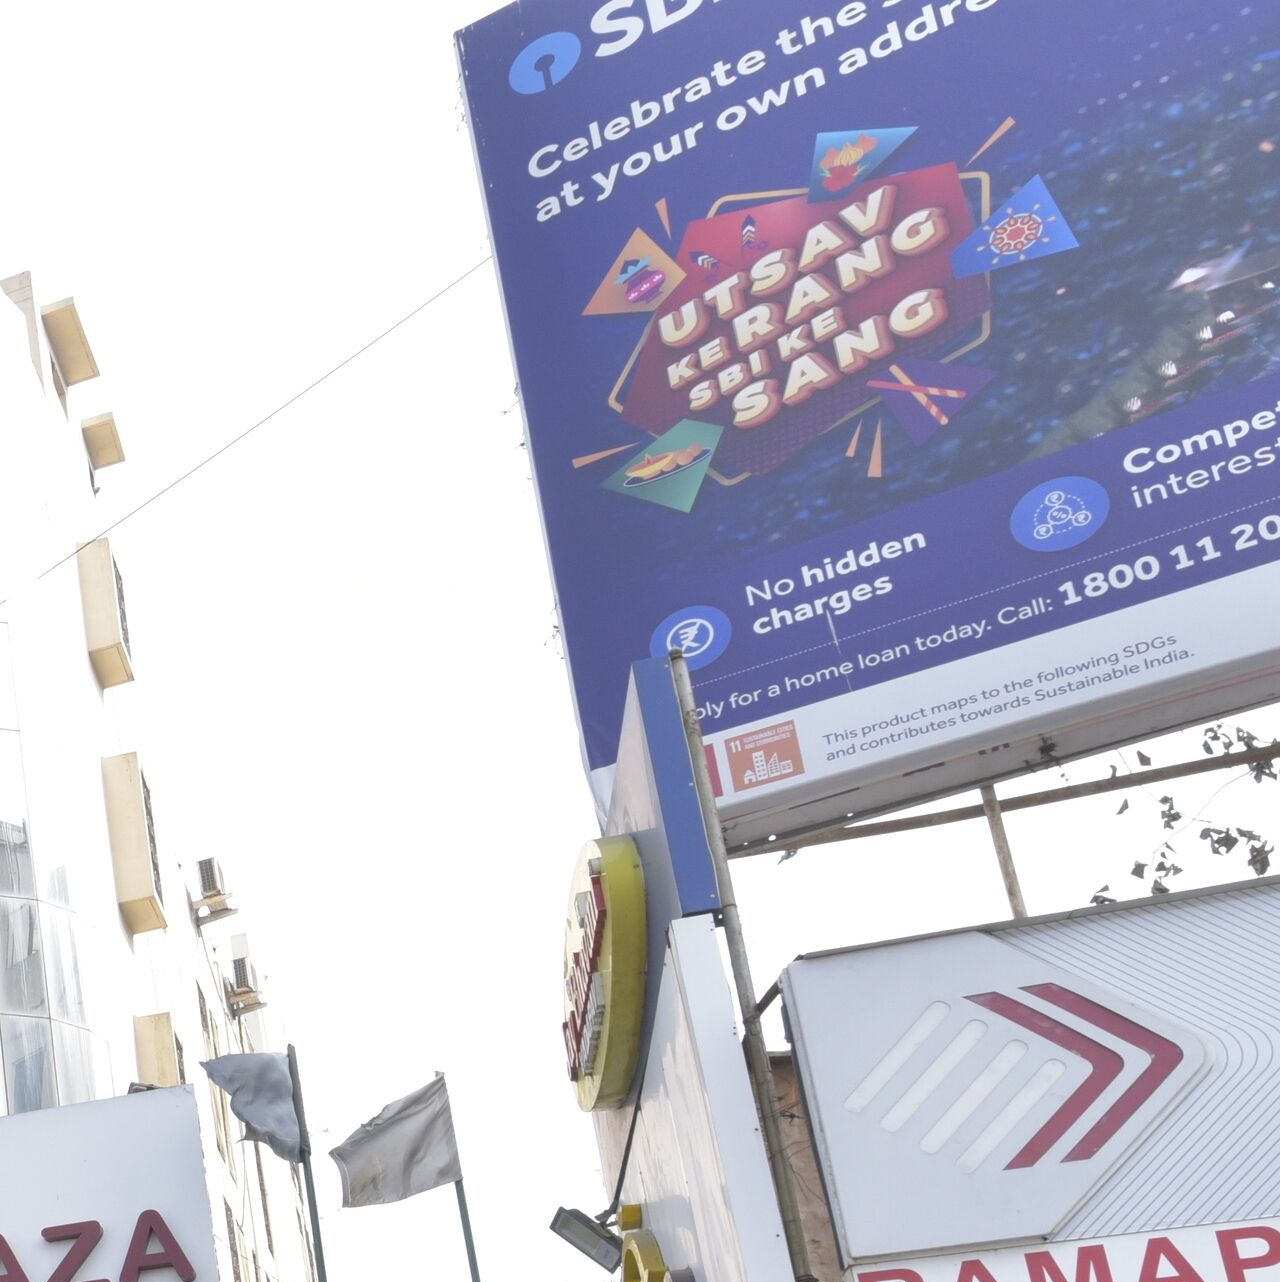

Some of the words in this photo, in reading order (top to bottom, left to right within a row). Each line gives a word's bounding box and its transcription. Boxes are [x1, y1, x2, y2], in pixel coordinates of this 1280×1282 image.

[528, 50, 766, 178] Celebrate
[775, 1, 867, 55] the
[536, 180, 584, 222] at
[591, 122, 704, 202] your
[716, 66, 826, 131] own
[658, 185, 897, 347] UTSAV
[667, 336, 731, 390] KE
[733, 207, 949, 352] RANG
[689, 349, 770, 411] SBI
[777, 307, 847, 361] KE
[733, 289, 948, 428] SANG
[729, 688, 762, 710] for
[767, 684, 781, 698] a
[784, 659, 854, 692] home
[857, 643, 911, 669] loan
[914, 619, 992, 652] today.
[997, 597, 1054, 626] Call:
[1058, 555, 1160, 606] 1800
[1169, 536, 1221, 570] 11
[745, 576, 794, 606] No
[801, 532, 927, 588] hidden
[753, 576, 893, 634] charges
[729, 740, 741, 753] 11
[822, 728, 857, 746] This
[860, 707, 928, 742] product
[931, 696, 978, 721] maps
[981, 688, 1001, 703] to
[1004, 677, 1034, 696] the
[1037, 651, 1120, 687] following
[1123, 634, 1177, 659] SDGs
[825, 743, 855, 762] and
[859, 716, 957, 752] contributes
[960, 697, 1031, 727] towards
[1034, 663, 1141, 701] Sustainable
[1144, 650, 1196, 673] India.
